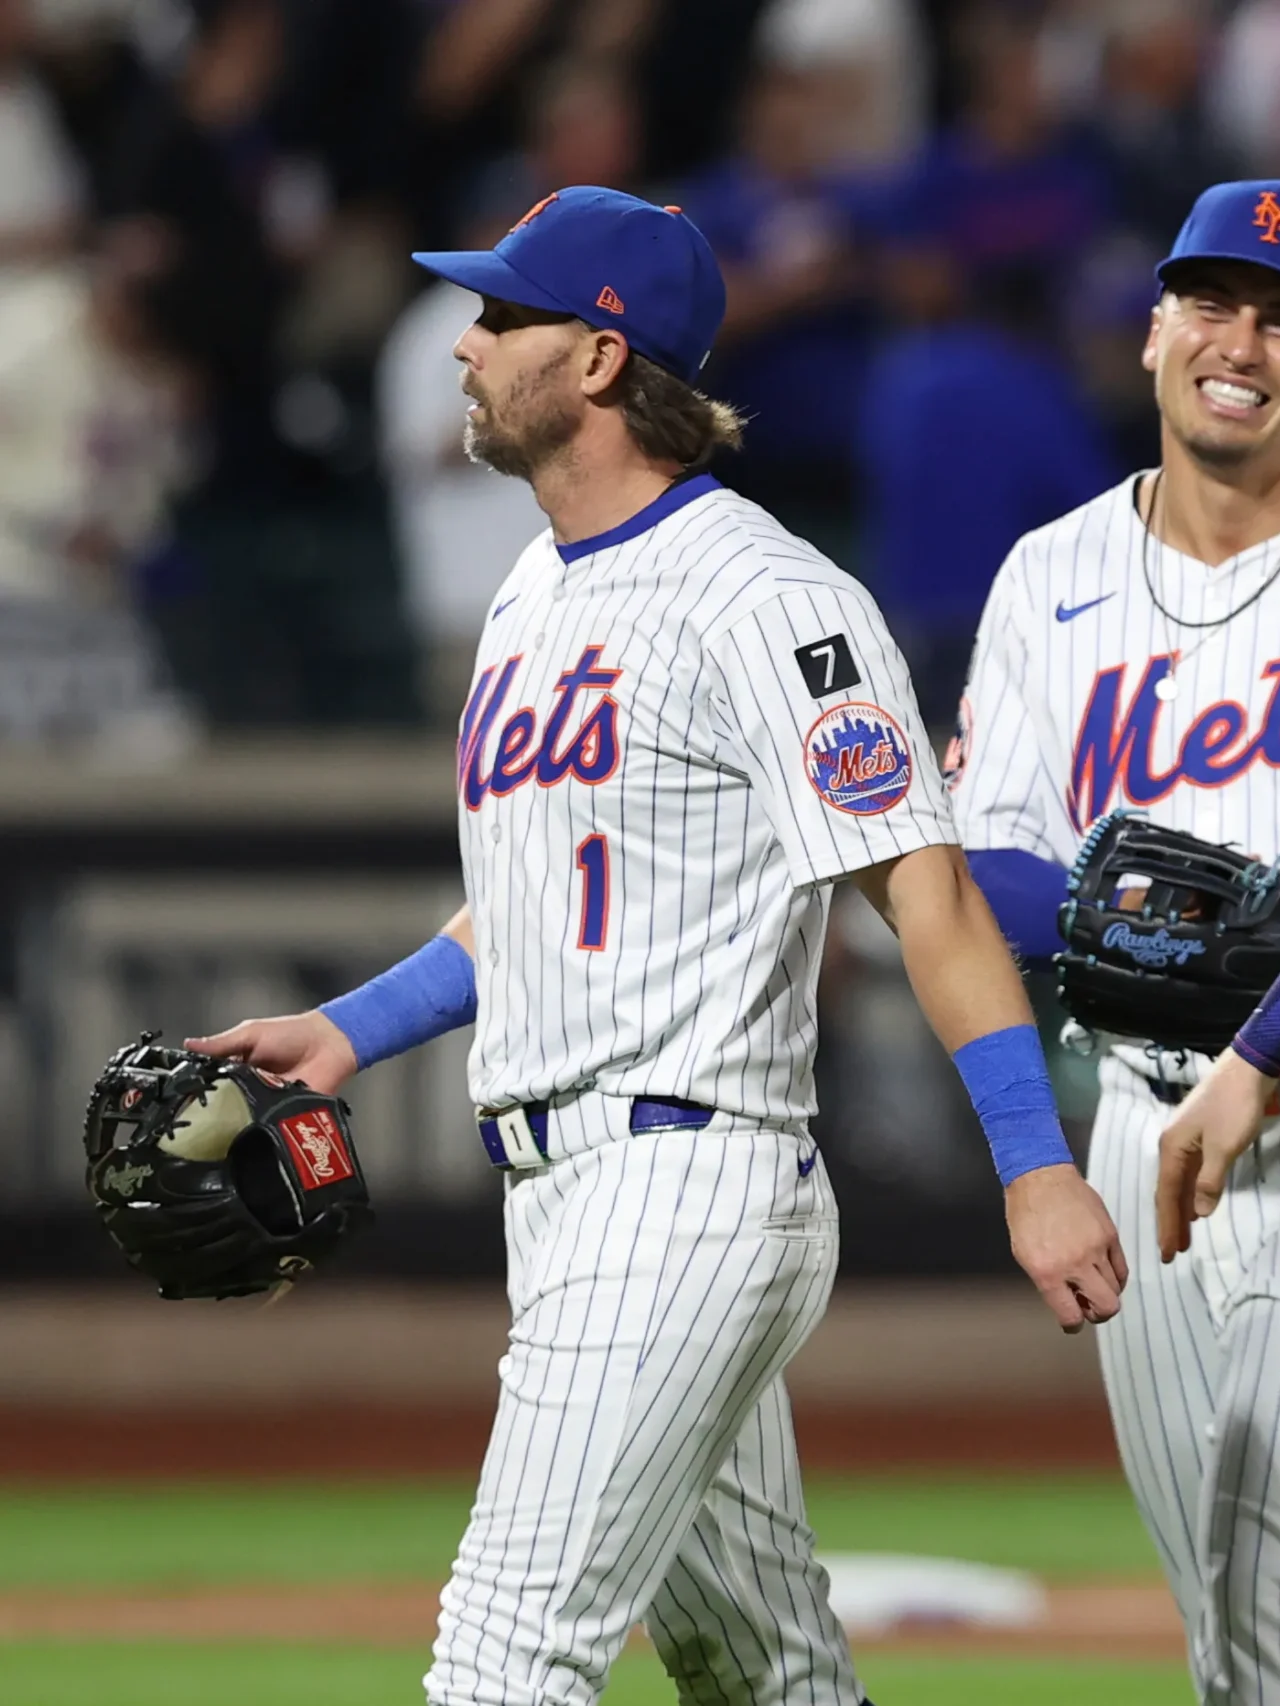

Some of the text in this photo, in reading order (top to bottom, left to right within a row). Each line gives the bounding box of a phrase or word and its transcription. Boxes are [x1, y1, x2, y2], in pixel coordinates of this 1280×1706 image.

[810, 645, 836, 689] 7
[829, 739, 897, 791] Mets
[576, 833, 611, 951] 1
[1103, 922, 1206, 967] Rawlings
